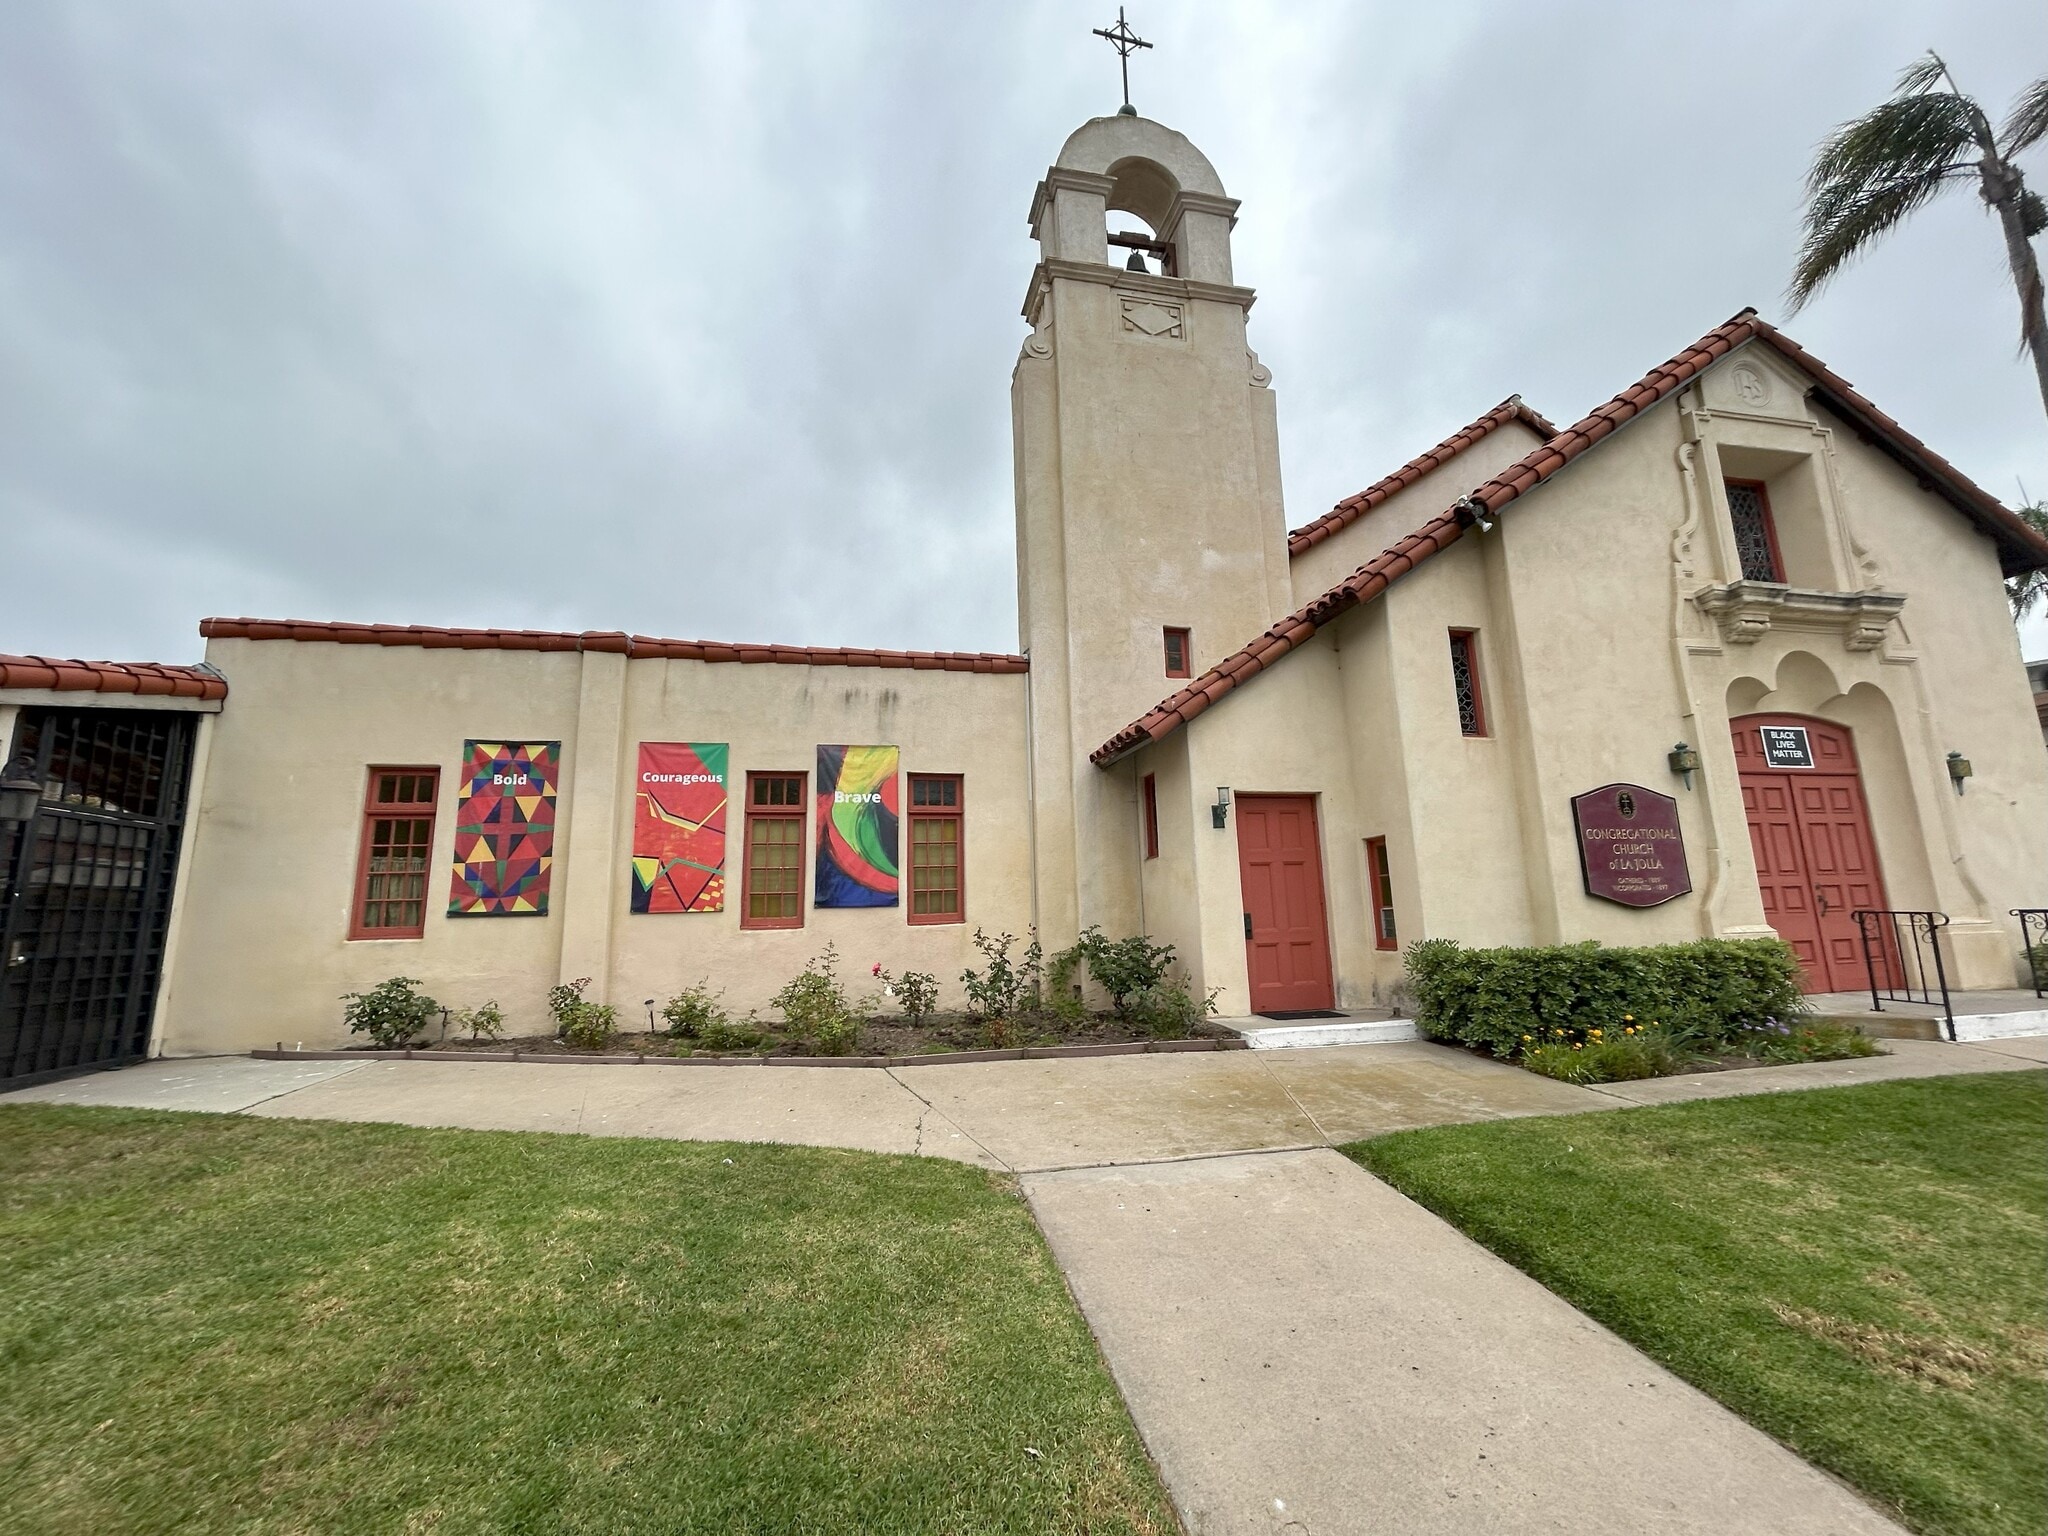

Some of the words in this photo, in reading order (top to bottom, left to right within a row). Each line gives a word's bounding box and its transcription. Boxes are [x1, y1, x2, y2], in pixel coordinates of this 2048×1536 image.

[1770, 731, 1796, 739] BLACK
[1776, 741, 1796, 749] LIVES
[1772, 750, 1804, 758] MATTER
[493, 773, 527, 785] Bold
[642, 772, 723, 786] Courageous
[834, 790, 882, 804] Brave
[1585, 828, 1677, 840] CONGREGATIONAL
[1612, 843, 1655, 855] CHURCH
[1609, 860, 1619, 870] of
[1620, 858, 1633, 870] LA
[1634, 858, 1664, 871] JOLLA
